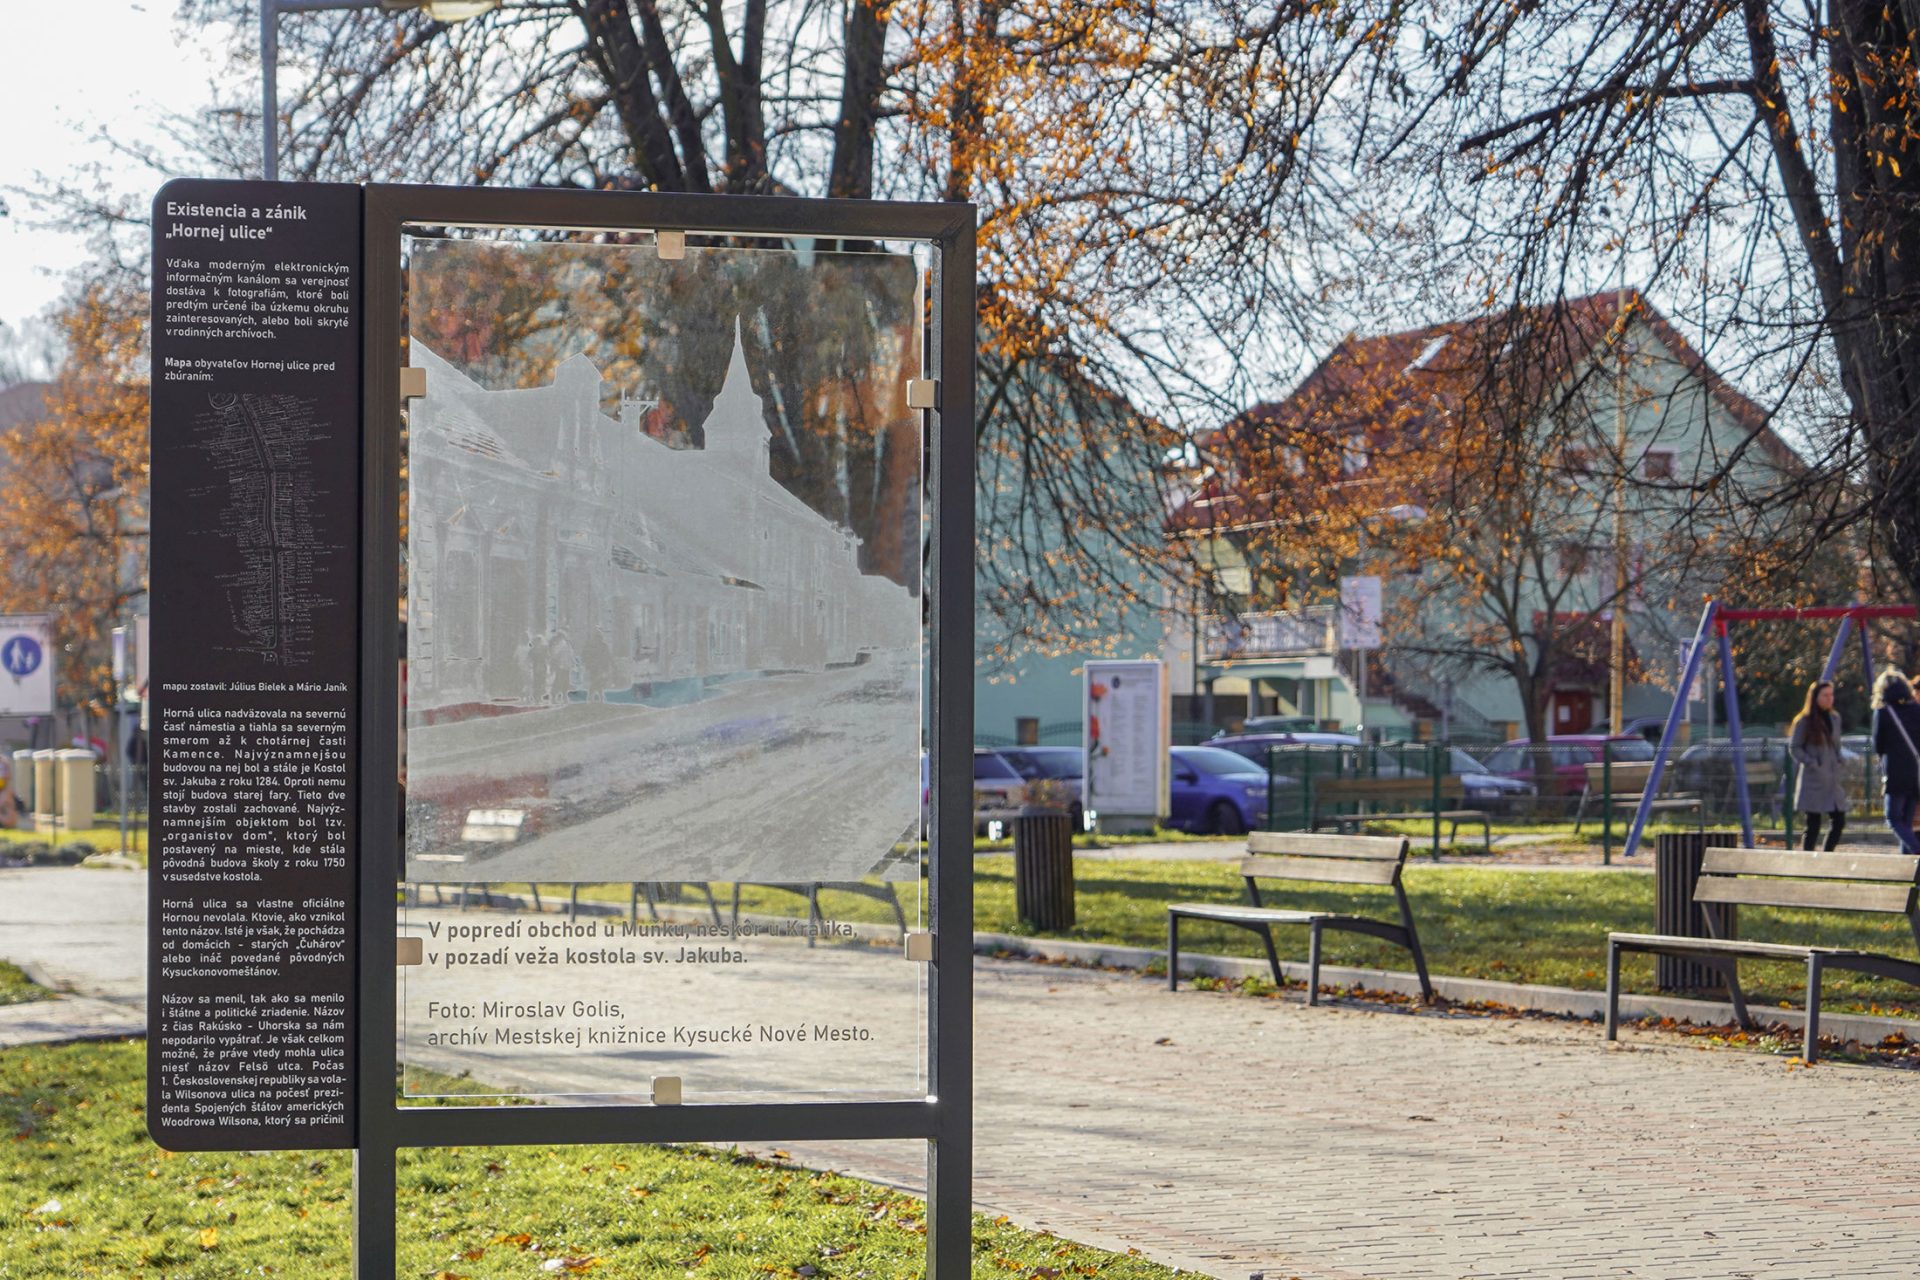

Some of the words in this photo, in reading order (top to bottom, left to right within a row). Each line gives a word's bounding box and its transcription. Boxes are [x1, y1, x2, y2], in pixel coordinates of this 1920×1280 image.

[166, 201, 246, 218] Existencia
[251, 207, 260, 218] a
[265, 203, 307, 219] zánik
[165, 257, 200, 268] Vďaka
[208, 259, 265, 272] moderným
[274, 261, 349, 275] elektronickým
[166, 271, 232, 285] informačným
[237, 272, 280, 284] kanálom
[284, 277, 297, 285] sa
[301, 276, 349, 288] verejnosť
[166, 284, 206, 296] dostáva
[213, 286, 220, 296] k
[227, 286, 288, 300] fotografiám,
[296, 288, 323, 299] ktoré
[330, 289, 349, 300] boli
[165, 298, 208, 311] predtým
[211, 299, 247, 311] určené
[250, 301, 266, 311] iba
[269, 300, 309, 312] úzkemu
[313, 303, 349, 313] okruhu
[165, 312, 257, 326] zainteresovaných,
[261, 315, 289, 325] alebo
[294, 316, 312, 326] boli
[317, 316, 349, 329] skryté
[173, 326, 223, 339] rodinných
[224, 327, 276, 338] archívoch.
[164, 356, 192, 369] Mapa
[194, 358, 248, 370] obyvateľov
[250, 359, 284, 372] Hornej
[286, 360, 310, 370] ulice
[312, 361, 335, 372] pred
[164, 369, 213, 381] zbúraním:
[162, 683, 188, 692] mapu
[189, 681, 227, 690] zostavil:
[228, 680, 256, 691] Július
[258, 681, 286, 691] Bielek
[296, 681, 321, 691] Mário
[323, 681, 347, 691] Janík
[163, 706, 194, 718] Horná
[197, 708, 221, 718] ulica
[224, 708, 287, 718] nadväzovala
[289, 710, 302, 718] na
[305, 707, 346, 719] severnú
[162, 737, 209, 745] smerom
[218, 734, 231, 745] až
[240, 735, 247, 745] k
[255, 734, 310, 747] chotárnej
[318, 734, 346, 746] časti
[163, 748, 224, 759] Kamence.
[234, 747, 346, 761] Najvýznamnejšou
[162, 788, 185, 801] stojí
[190, 789, 227, 799] budova
[233, 789, 263, 802] starej
[268, 789, 291, 801] fary.
[296, 789, 322, 799] Tieto
[327, 790, 346, 800] dve
[162, 803, 196, 815] stavby
[202, 803, 236, 813] zostali
[243, 802, 299, 813] zachované.
[306, 802, 345, 815] Najvýz-
[162, 815, 226, 829] namnejším
[235, 816, 289, 829] objektom
[298, 816, 316, 827] bol
[325, 817, 345, 827] tzv.
[162, 843, 216, 856] postavený
[224, 846, 237, 854] na
[245, 844, 284, 855] mieste,
[292, 843, 311, 854] kde
[319, 842, 345, 854] stála
[162, 873, 169, 881] v
[169, 871, 221, 881] susedstve
[222, 871, 262, 881] kostola.
[162, 897, 194, 908] Horná
[202, 898, 227, 908] ulica
[235, 900, 248, 908] sa
[256, 898, 294, 908] vlastne
[302, 896, 345, 908] oficiálne
[162, 912, 200, 922] Hornou
[202, 911, 248, 922] nevolala.
[251, 911, 285, 922] Ktovie,
[288, 911, 306, 921] ako
[309, 911, 345, 921] vznikol
[428, 920, 441, 938] V
[447, 918, 522, 943] popredí
[527, 920, 596, 938] obchod
[603, 919, 614, 937] u
[696, 918, 763, 937] neskôr
[768, 923, 779, 937] u
[161, 953, 191, 963] alebo
[199, 951, 221, 963] ináč
[230, 951, 281, 964] povedané
[289, 951, 345, 964] pôvodných
[427, 952, 439, 965] v
[445, 945, 509, 970] pozadí
[514, 945, 558, 964] veža
[565, 946, 636, 964] kostola
[642, 950, 669, 964] sv.
[674, 946, 748, 963] Jakuba.
[161, 964, 280, 979] Kysuckonovomeštánov.
[428, 1001, 475, 1018] Foto:
[482, 1000, 566, 1018] Miroslav
[572, 999, 624, 1019] Golis,
[161, 1034, 216, 1047] nepodarilo
[218, 1033, 263, 1046] vypátrať.
[266, 1033, 278, 1044] Je
[281, 1032, 305, 1043] však
[307, 1033, 344, 1043] celkom
[427, 1027, 488, 1046] archív
[495, 1026, 581, 1048] Mestskej
[588, 1024, 666, 1044] knižnice
[673, 1023, 752, 1047] Kysucké
[759, 1022, 807, 1042] Nové
[813, 1024, 876, 1041] Mesto.
[161, 1047, 198, 1059] možné,
[202, 1047, 215, 1058] že
[219, 1046, 248, 1060] práve
[252, 1047, 280, 1059] vtedy
[284, 1047, 316, 1057] mohla
[320, 1046, 344, 1056] ulica
[161, 1061, 189, 1072] niesť
[198, 1060, 230, 1072] názov
[277, 1061, 303, 1071] utca.
[312, 1059, 344, 1070] Počas
[161, 1075, 168, 1085] 1.
[172, 1073, 258, 1087] Československej
[258, 1074, 306, 1086] republiky
[306, 1075, 319, 1084] sa
[320, 1073, 346, 1083] vola-
[161, 1089, 171, 1099] la
[174, 1089, 227, 1099] Wilsonova
[230, 1088, 255, 1098] ulica
[259, 1090, 272, 1098] na
[275, 1087, 310, 1100] počesť
[313, 1087, 344, 1099] prezi-
[161, 1103, 190, 1113] denta
[194, 1101, 246, 1114] Spojených
[250, 1100, 282, 1112] štátov
[286, 1099, 344, 1113] amerických
[160, 1116, 215, 1127] Woodrowa
[218, 1115, 261, 1126] Wilsona,
[264, 1113, 291, 1127] ktorý
[294, 1116, 306, 1125] sa
[309, 1113, 344, 1126] pričinil
